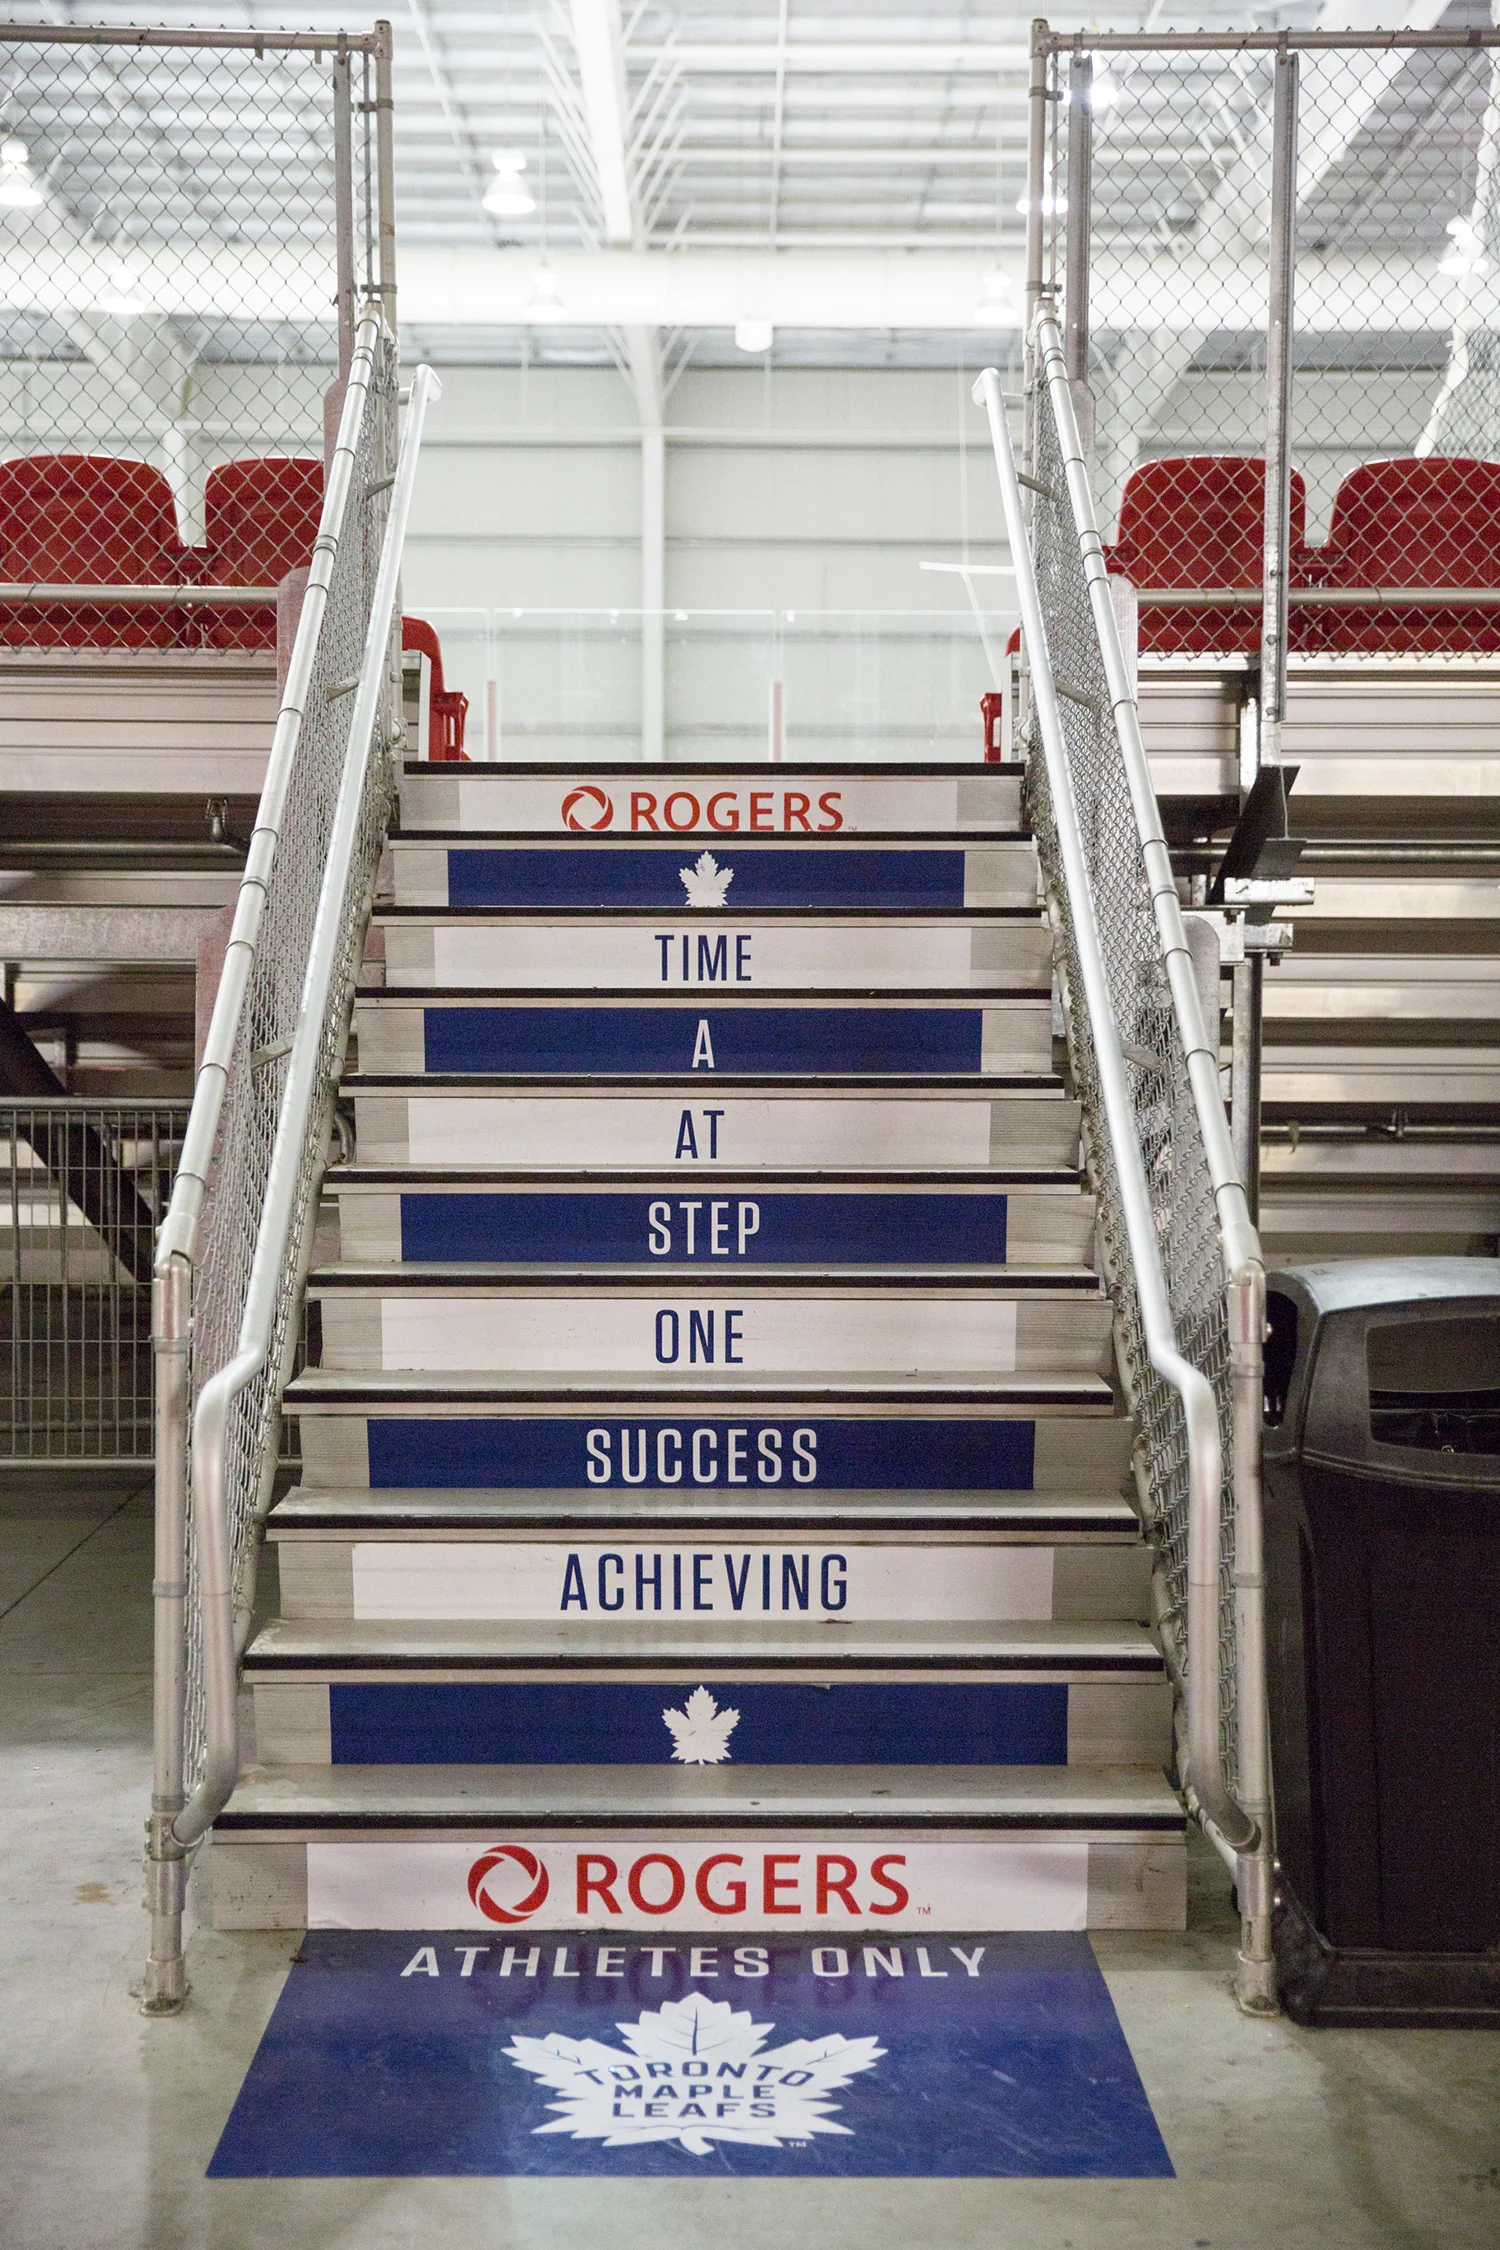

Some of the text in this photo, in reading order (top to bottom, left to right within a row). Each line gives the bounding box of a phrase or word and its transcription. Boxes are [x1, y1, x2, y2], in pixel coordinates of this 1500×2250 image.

[630, 791, 843, 832] ROGERS
[654, 934, 752, 981] TIME
[691, 1019, 715, 1068] A
[675, 1109, 725, 1159] AT
[648, 1201, 760, 1255] STEP
[655, 1309, 744, 1364] ONE
[586, 1428, 817, 1483] SUCCESS
[560, 1553, 847, 1611] ACHIEVING
[576, 1853, 909, 1916] ROGERS
[400, 1946, 986, 1977] ATHLETES ONLY
[573, 2061, 815, 2087] TORONTO
[613, 2084, 776, 2100] MAPLE
[612, 2102, 776, 2119] LEAFS
